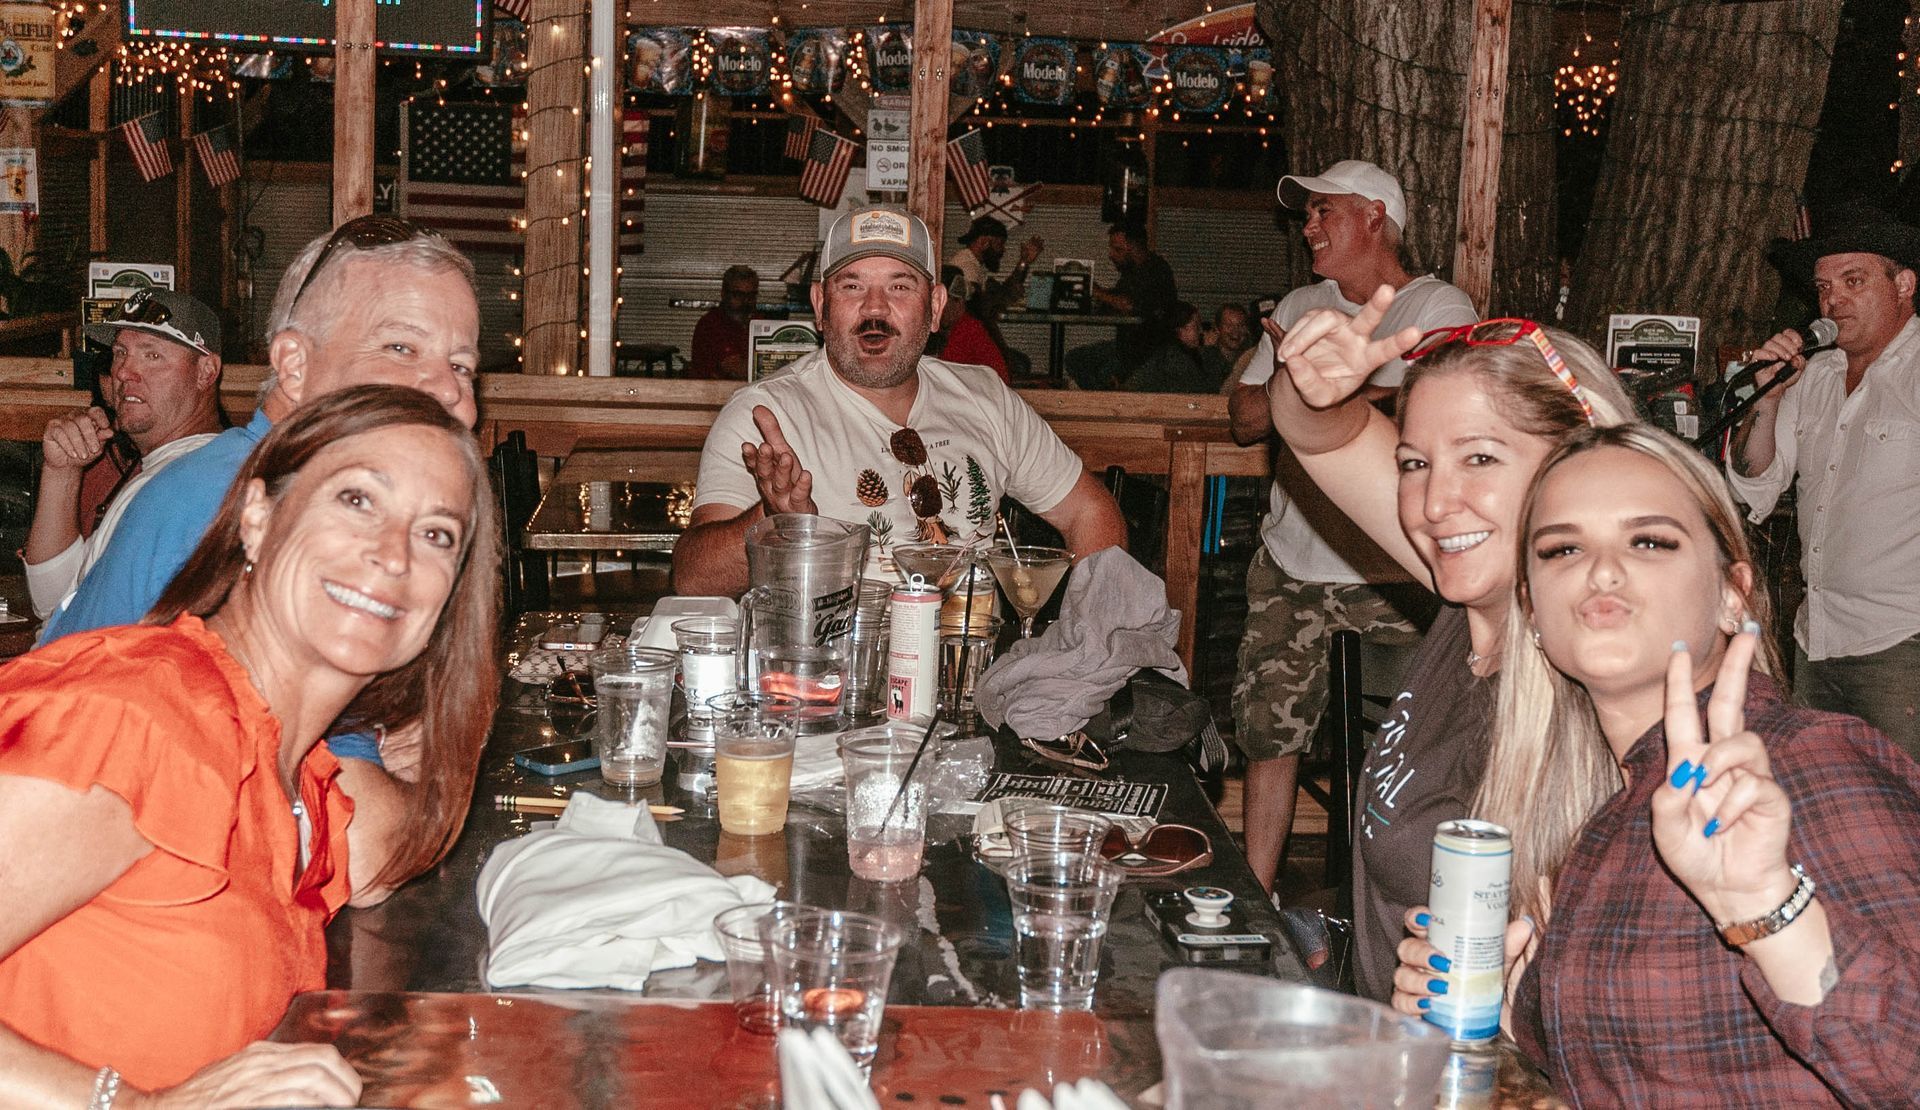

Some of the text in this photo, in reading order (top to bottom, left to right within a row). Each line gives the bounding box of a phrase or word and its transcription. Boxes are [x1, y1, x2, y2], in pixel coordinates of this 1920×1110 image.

[718, 54, 761, 72] Modelo
[1023, 62, 1067, 81] Modelo
[1176, 72, 1218, 89] Modelo
[871, 144, 884, 152] NO
[935, 439, 951, 448] TREE
